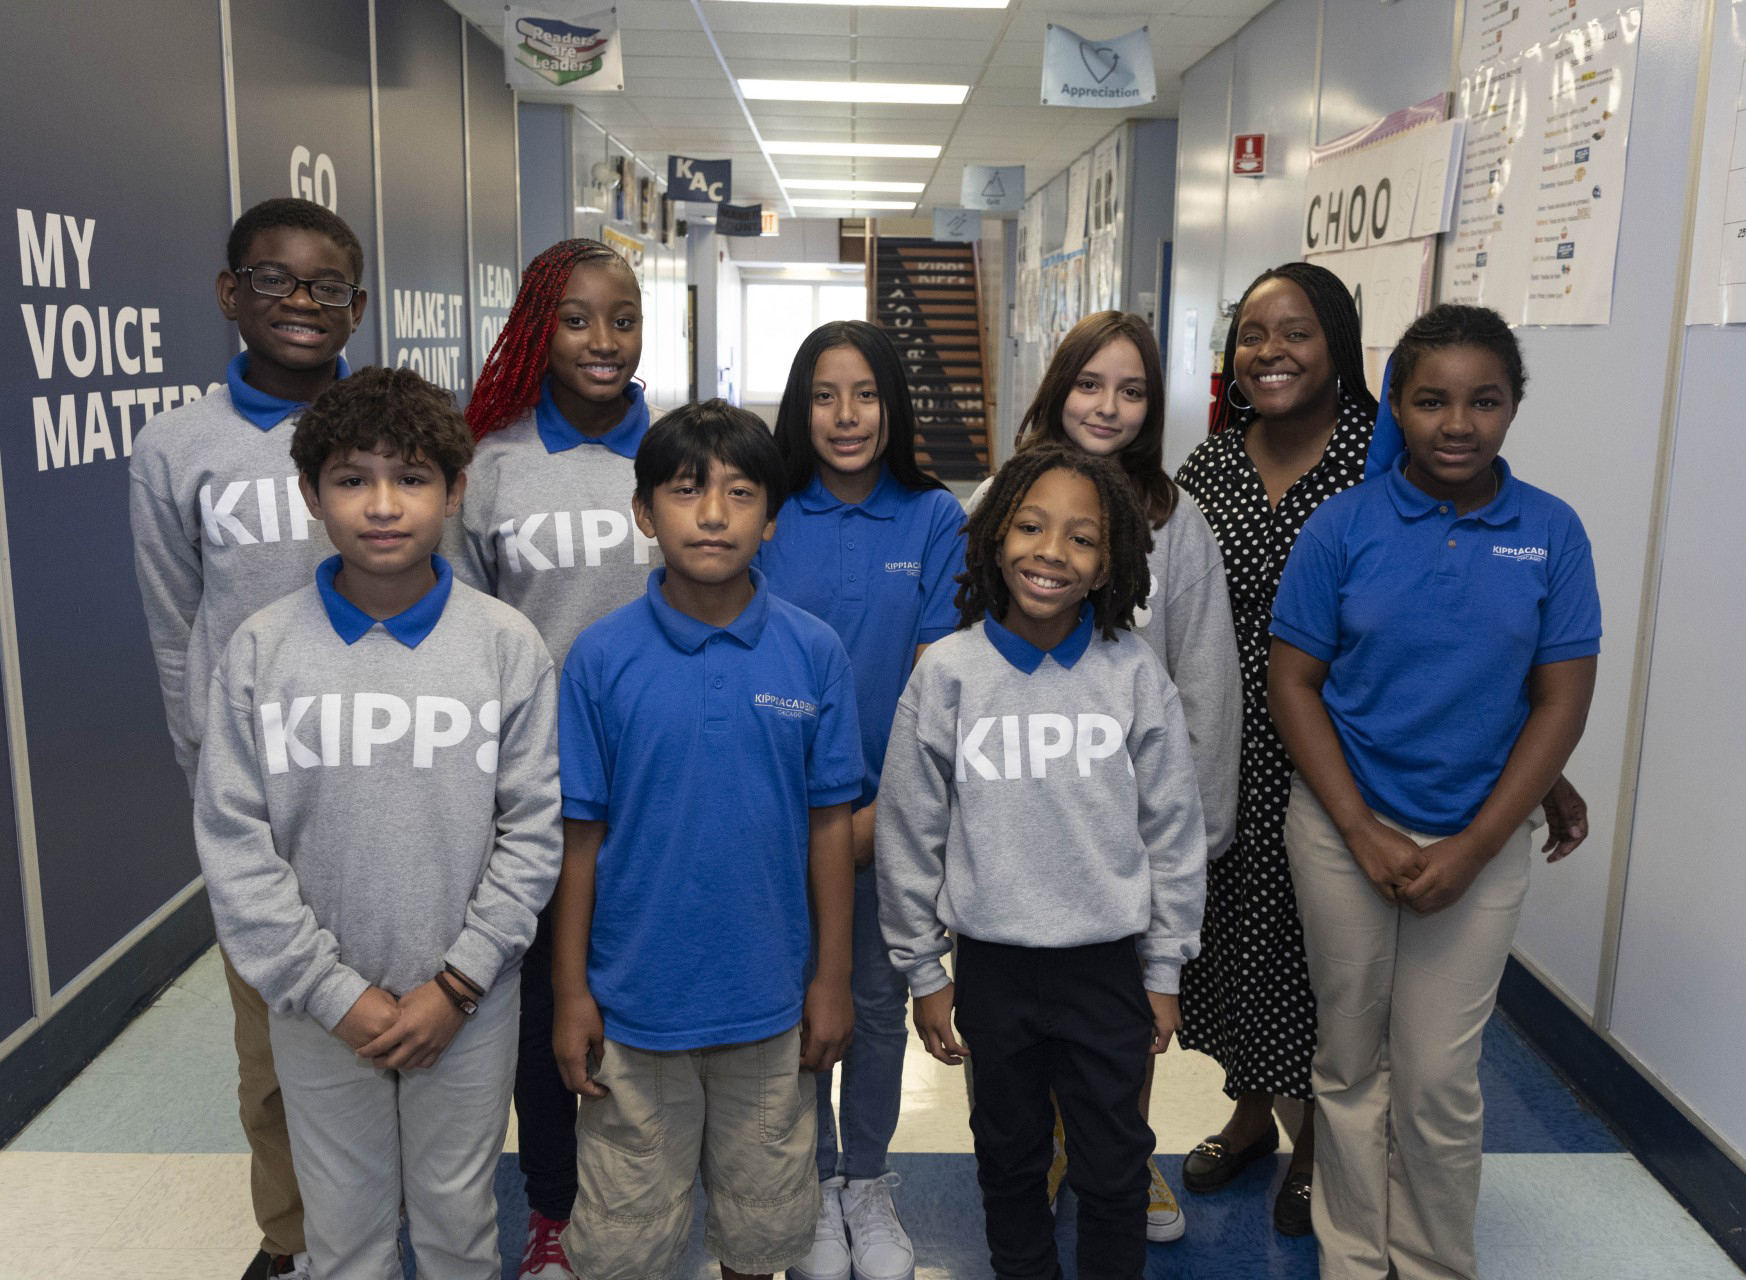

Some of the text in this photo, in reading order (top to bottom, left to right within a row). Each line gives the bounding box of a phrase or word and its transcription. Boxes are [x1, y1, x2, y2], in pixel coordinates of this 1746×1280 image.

[532, 26, 595, 46] Readers
[551, 45, 577, 58] are
[533, 54, 592, 71] Leaders
[1061, 83, 1140, 98] Appreciation
[290, 145, 337, 215] GO
[16, 208, 96, 290] MY
[479, 263, 513, 309] LEAD
[394, 288, 463, 339] MAKE IT
[21, 303, 163, 380] VOICE
[32, 382, 221, 472] MATT
[777, 709, 802, 718] CHICAGO
[955, 713, 1135, 782] KIPP
